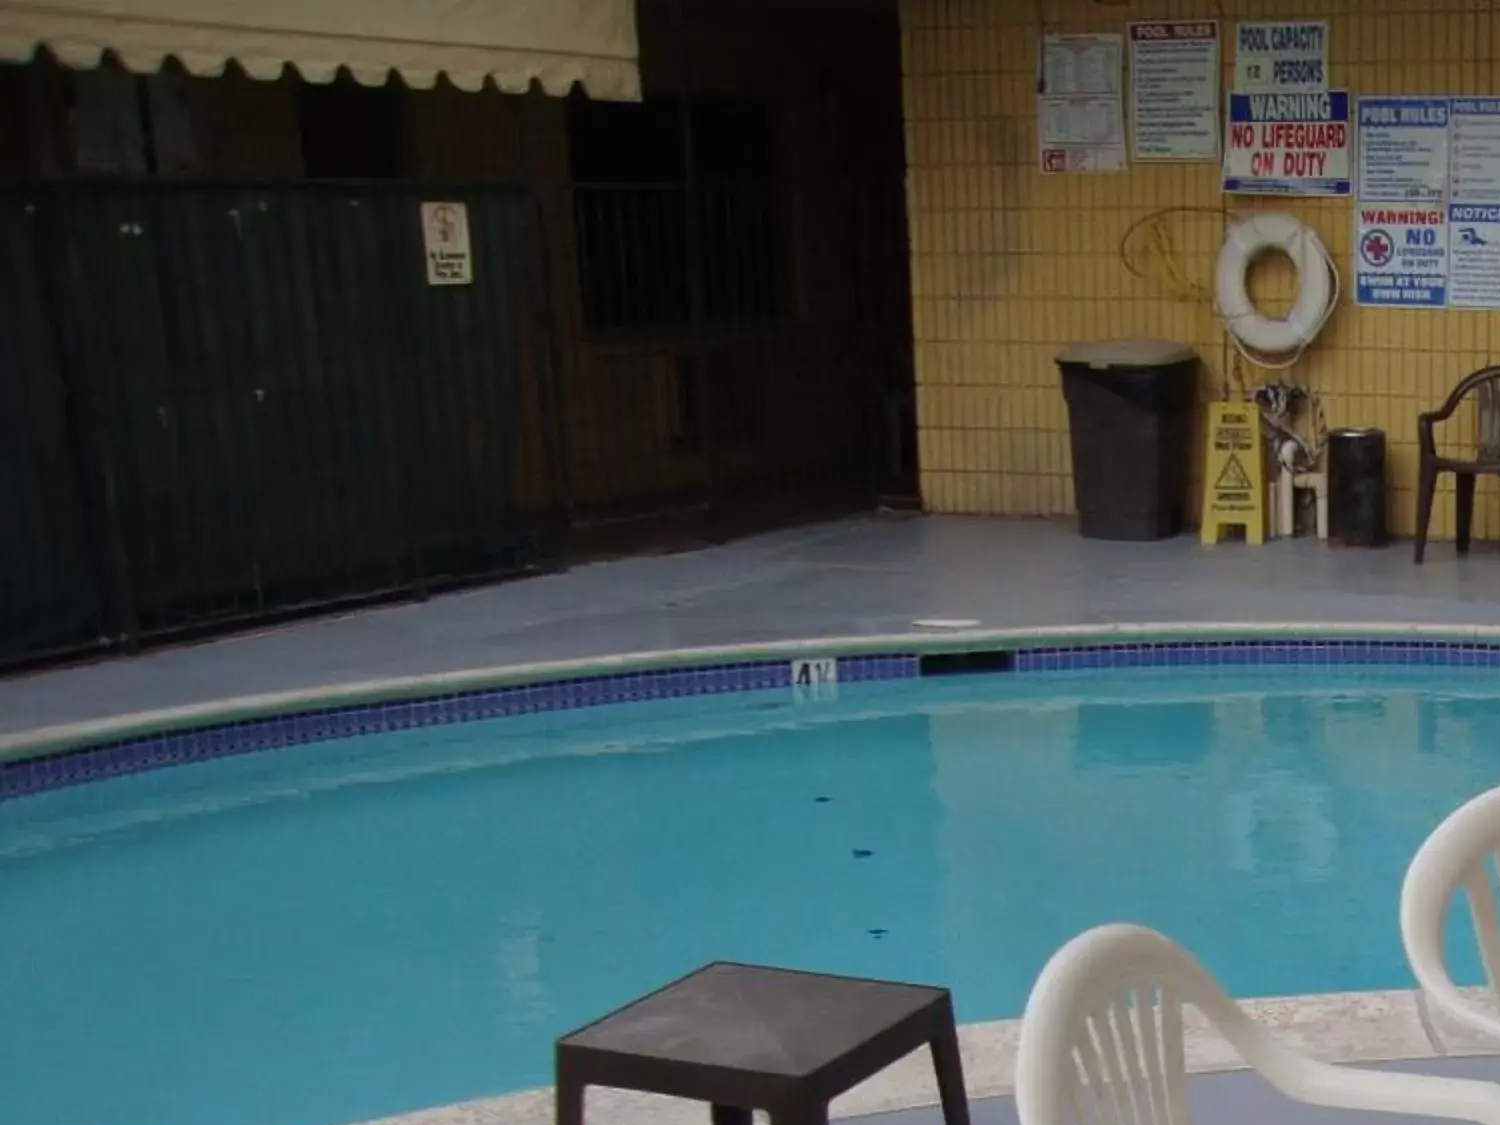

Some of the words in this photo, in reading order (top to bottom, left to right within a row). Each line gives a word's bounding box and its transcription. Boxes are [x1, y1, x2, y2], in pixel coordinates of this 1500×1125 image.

[1136, 25, 1169, 38] POOL
[1173, 24, 1212, 37] RULES
[1239, 27, 1269, 51] POOL
[1271, 25, 1323, 50] CAPACITY
[1273, 59, 1323, 84] PERSONS
[1249, 93, 1331, 120] WARNING
[1361, 107, 1398, 124] POOL
[1401, 106, 1446, 123] RULES
[1231, 126, 1255, 148] NO
[1262, 124, 1346, 148] LIFEGUARD
[1251, 152, 1274, 176] ON
[1284, 152, 1326, 176] DUTY
[1361, 209, 1444, 225] WARNING!
[1405, 228, 1436, 246] NO
[1417, 258, 1439, 268] DUTY
